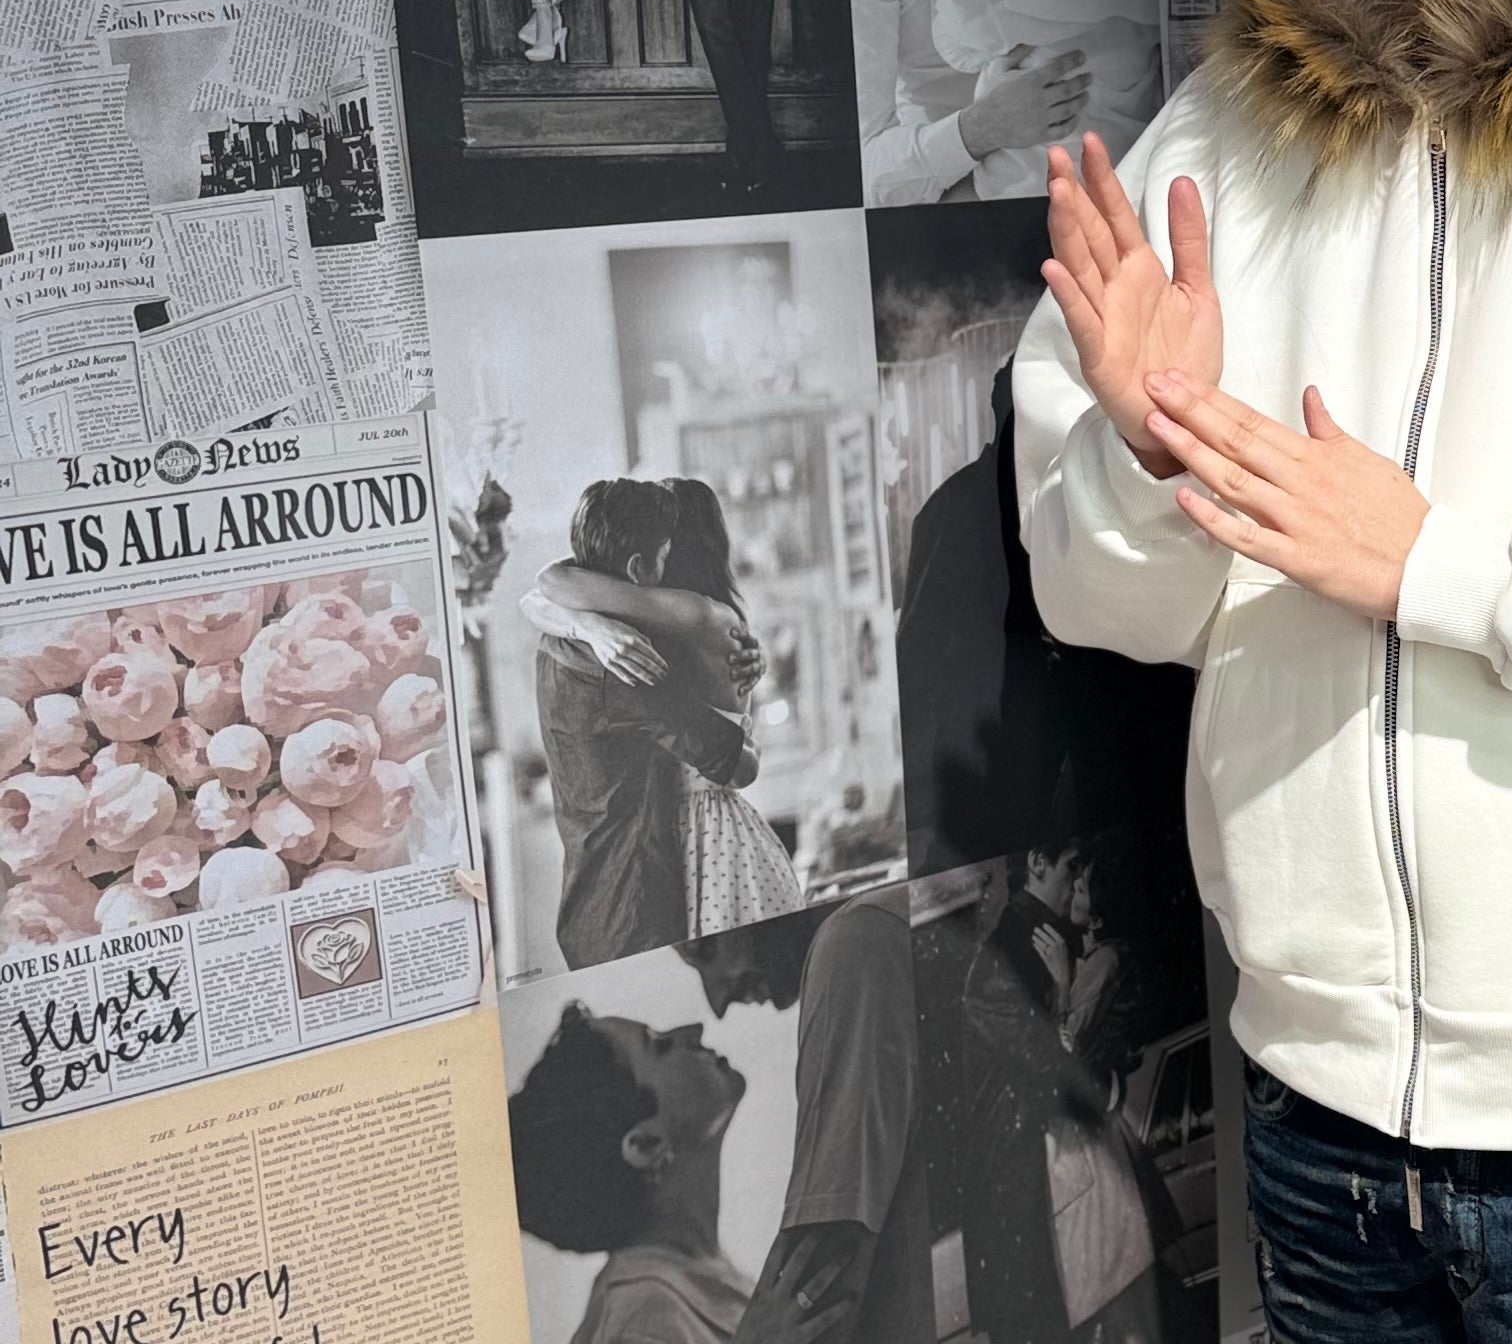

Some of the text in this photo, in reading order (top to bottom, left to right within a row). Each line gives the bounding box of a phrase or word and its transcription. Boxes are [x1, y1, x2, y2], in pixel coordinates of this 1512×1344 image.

[57, 435, 301, 493] Lady News
[59, 472, 428, 575] IS ALL ARROUND
[38, 1203, 187, 1282] Every
[166, 1265, 292, 1333] story
